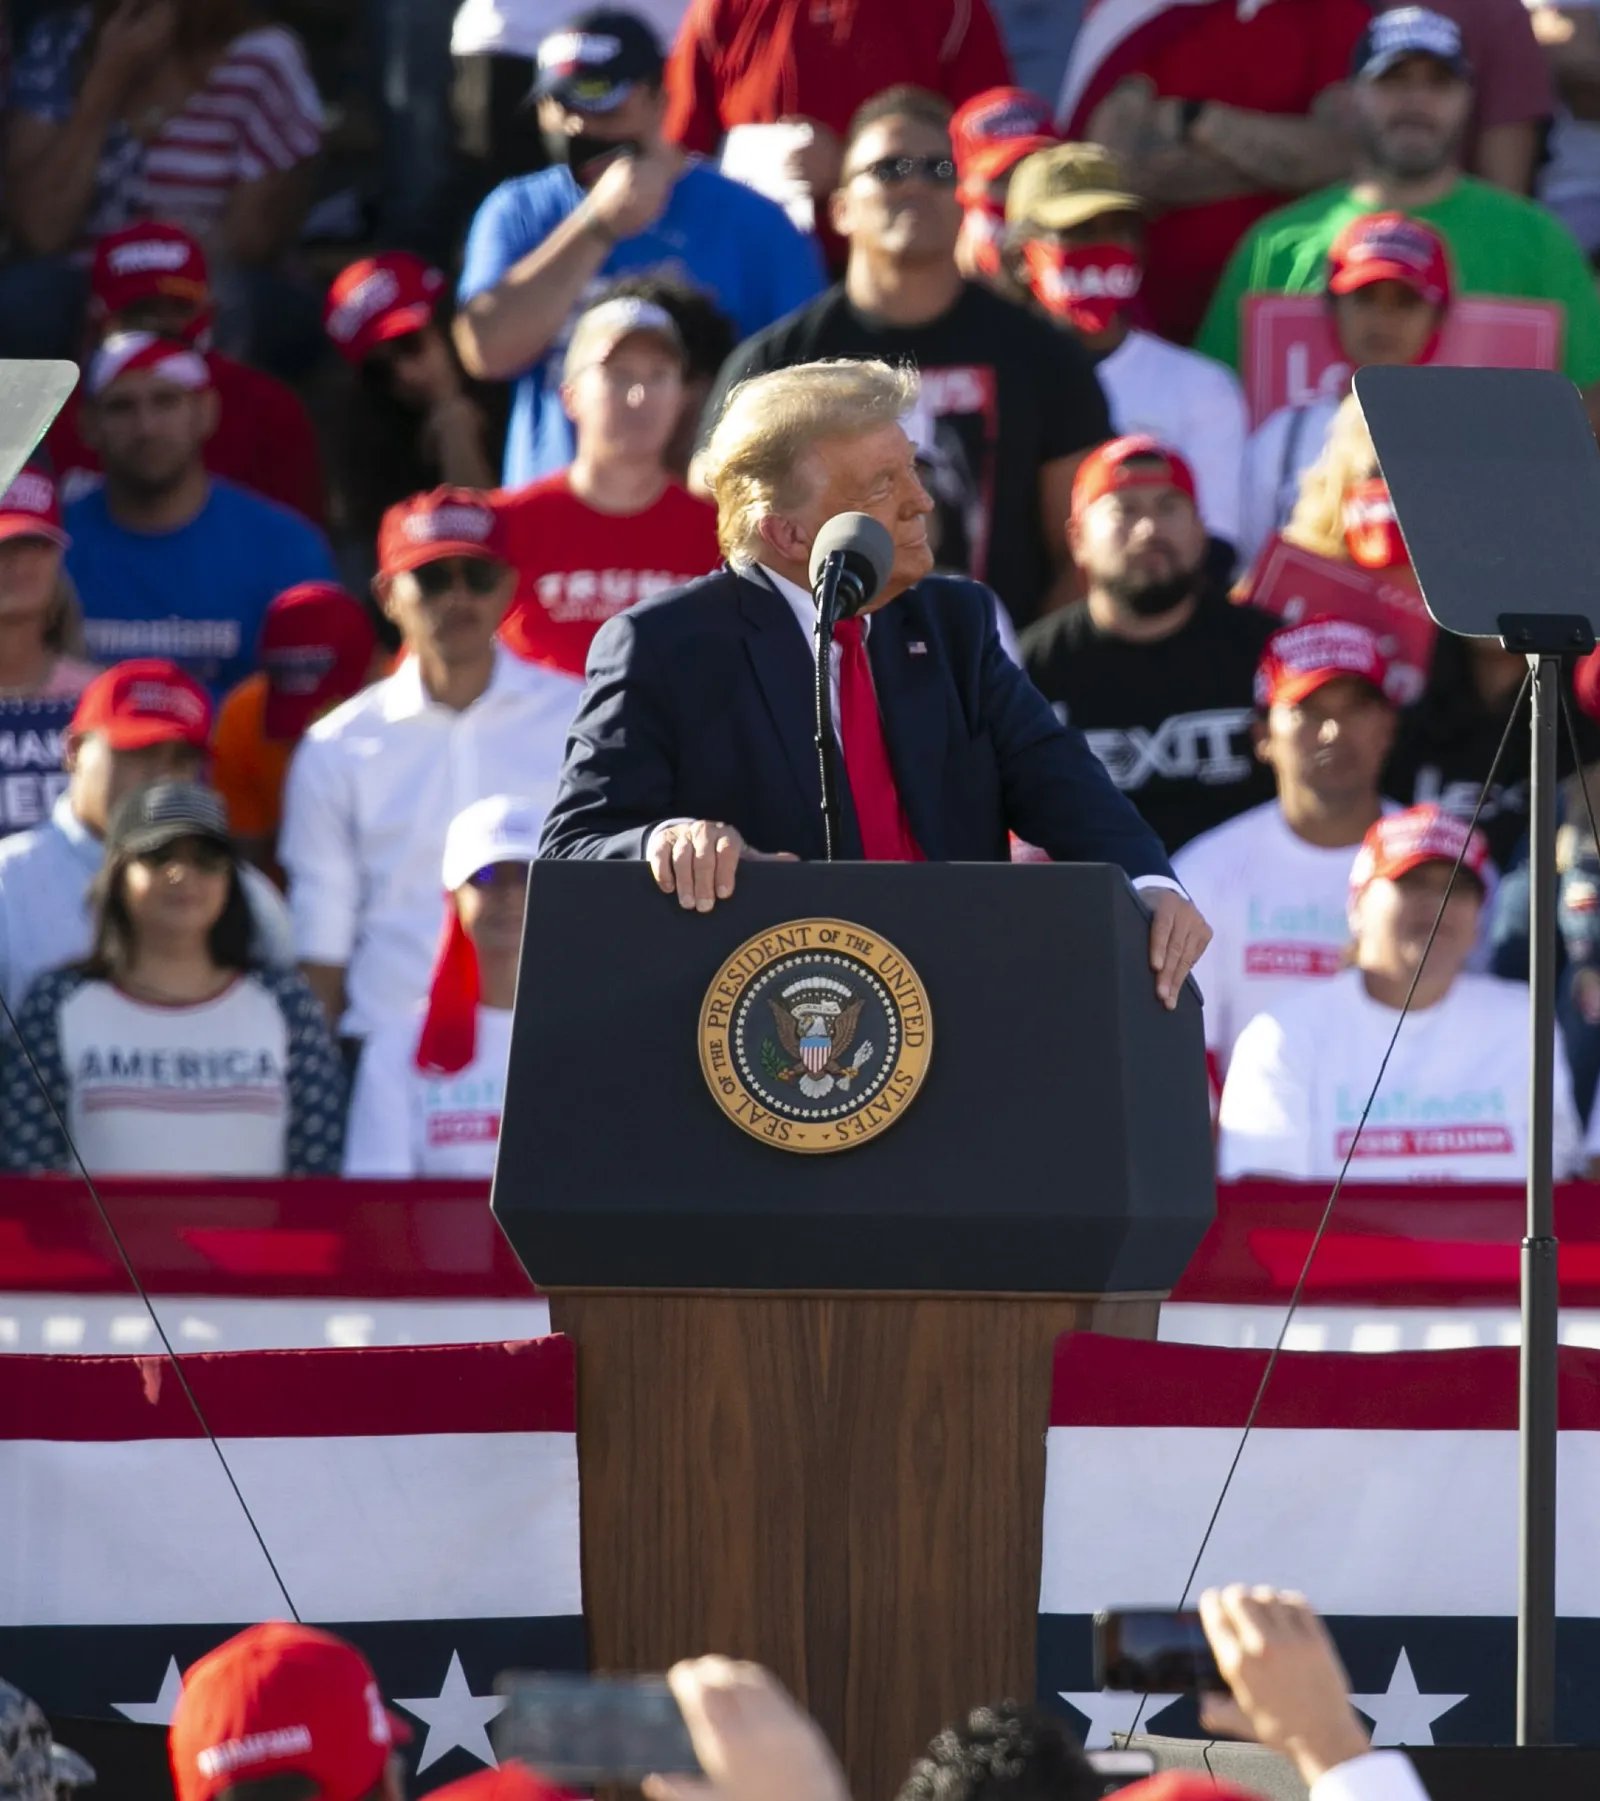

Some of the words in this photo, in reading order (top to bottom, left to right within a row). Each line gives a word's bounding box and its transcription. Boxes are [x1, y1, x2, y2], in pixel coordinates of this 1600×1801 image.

[533, 568, 700, 608] TRUM
[818, 928, 841, 944] OF
[845, 933, 876, 956] THE
[706, 926, 812, 1030] PRESIDENT
[877, 952, 926, 1049] UNITED
[80, 1045, 278, 1083] AMERICA
[708, 1038, 728, 1073] THE
[717, 1072, 737, 1096] OF
[734, 1092, 794, 1142] SEAL
[834, 1068, 915, 1142] STATES
